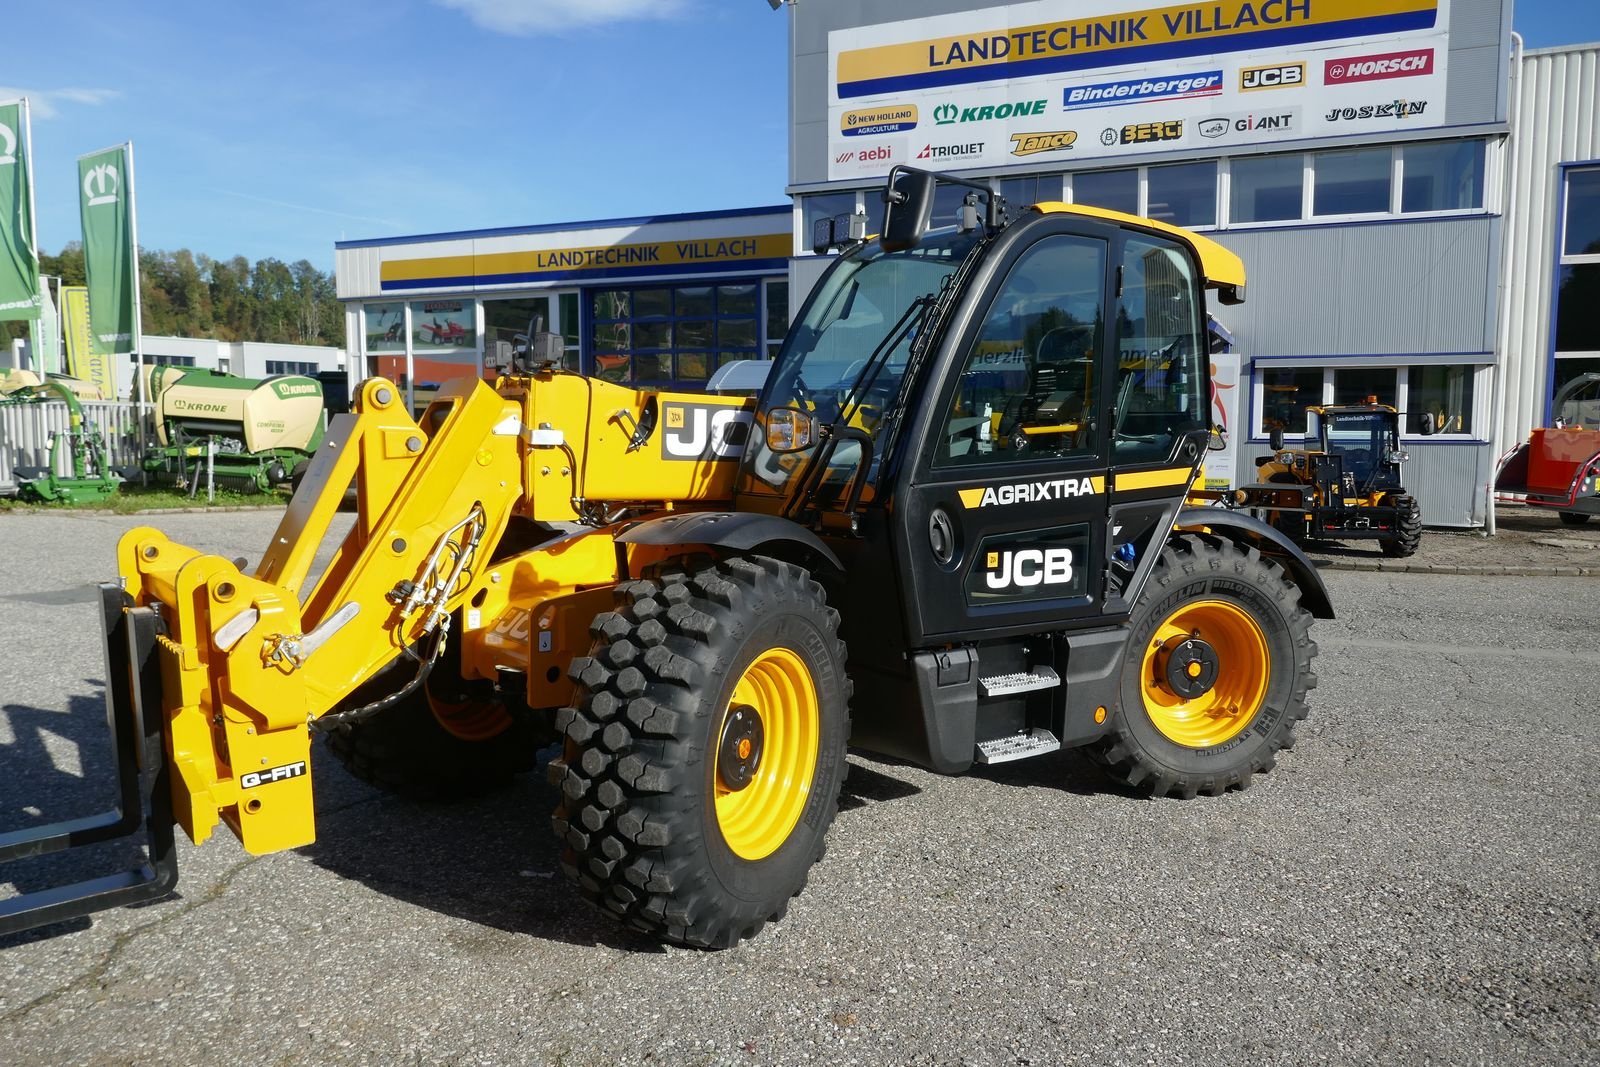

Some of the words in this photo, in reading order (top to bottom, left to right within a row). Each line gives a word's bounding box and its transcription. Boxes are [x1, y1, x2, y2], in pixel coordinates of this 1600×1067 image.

[928, 16, 1148, 67] LANDTECHNIK
[1162, 0, 1310, 36] VILLACH
[1243, 66, 1302, 88] JCB
[1346, 55, 1428, 77] HORSCH
[1068, 75, 1219, 103] Binderberger
[858, 114, 876, 123] NEW
[877, 110, 912, 121] HOLLAND
[960, 99, 1048, 123] KRONE
[1325, 100, 1427, 122] JOSKIN
[858, 124, 900, 134] AGRICULTURE
[858, 146, 891, 161] aebi
[931, 142, 985, 157] TRIOLIET
[1010, 131, 1078, 156] Tanco
[537, 245, 660, 269] LANDTECHNIK
[676, 239, 757, 259] VILLACH
[289, 384, 317, 394] KRONE
[187, 403, 228, 413] KRONE
[980, 477, 1095, 507] AGRIXTRA
[986, 548, 1073, 589] JCB
[242, 761, 305, 788] Q-FIT
